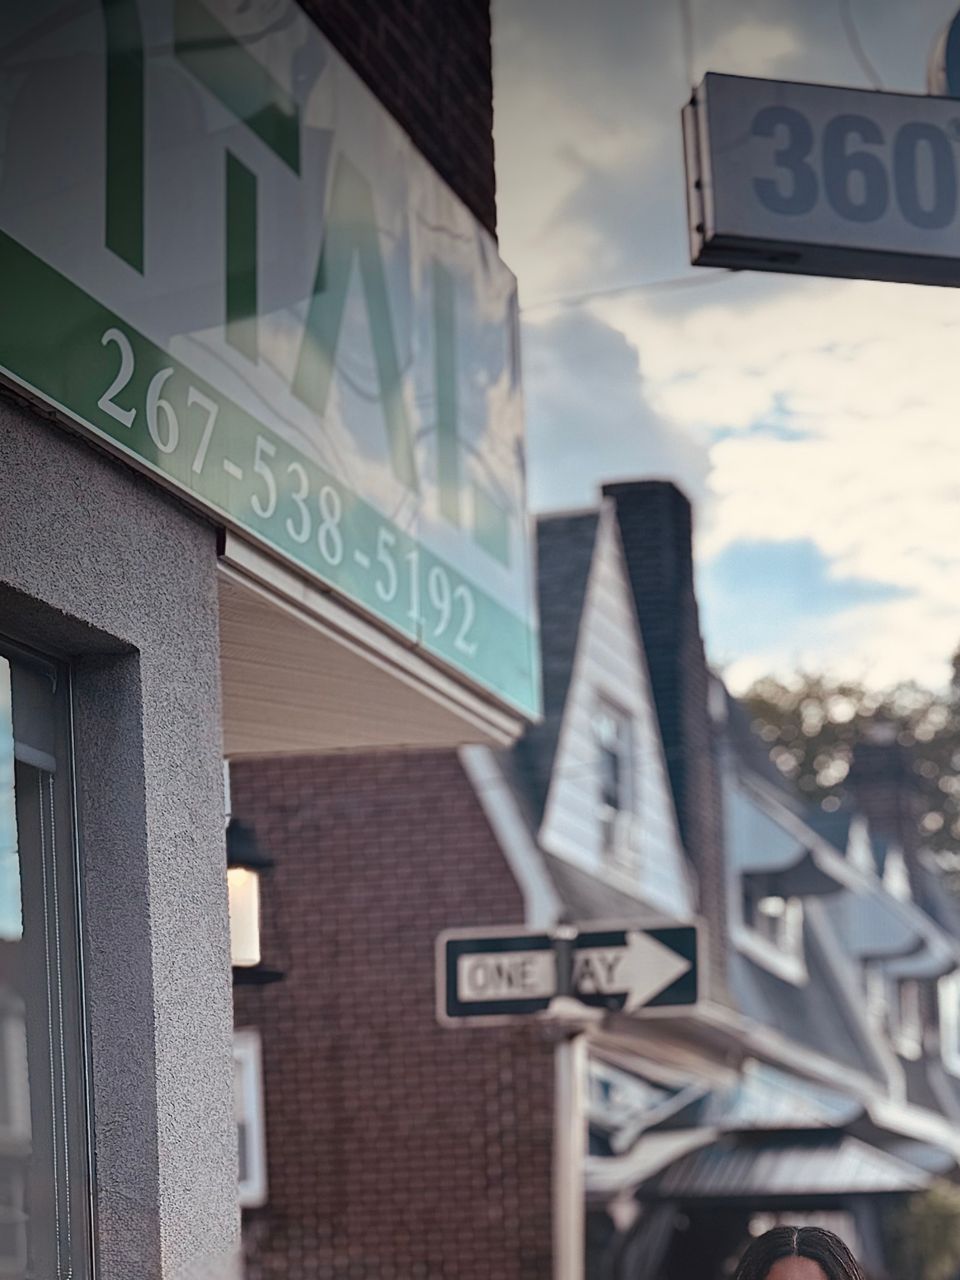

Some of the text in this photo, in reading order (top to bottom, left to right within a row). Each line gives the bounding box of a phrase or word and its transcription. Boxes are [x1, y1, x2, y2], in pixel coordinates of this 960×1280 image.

[98, 328, 477, 657] 267-538-5192
[468, 952, 623, 994] ONE AY
